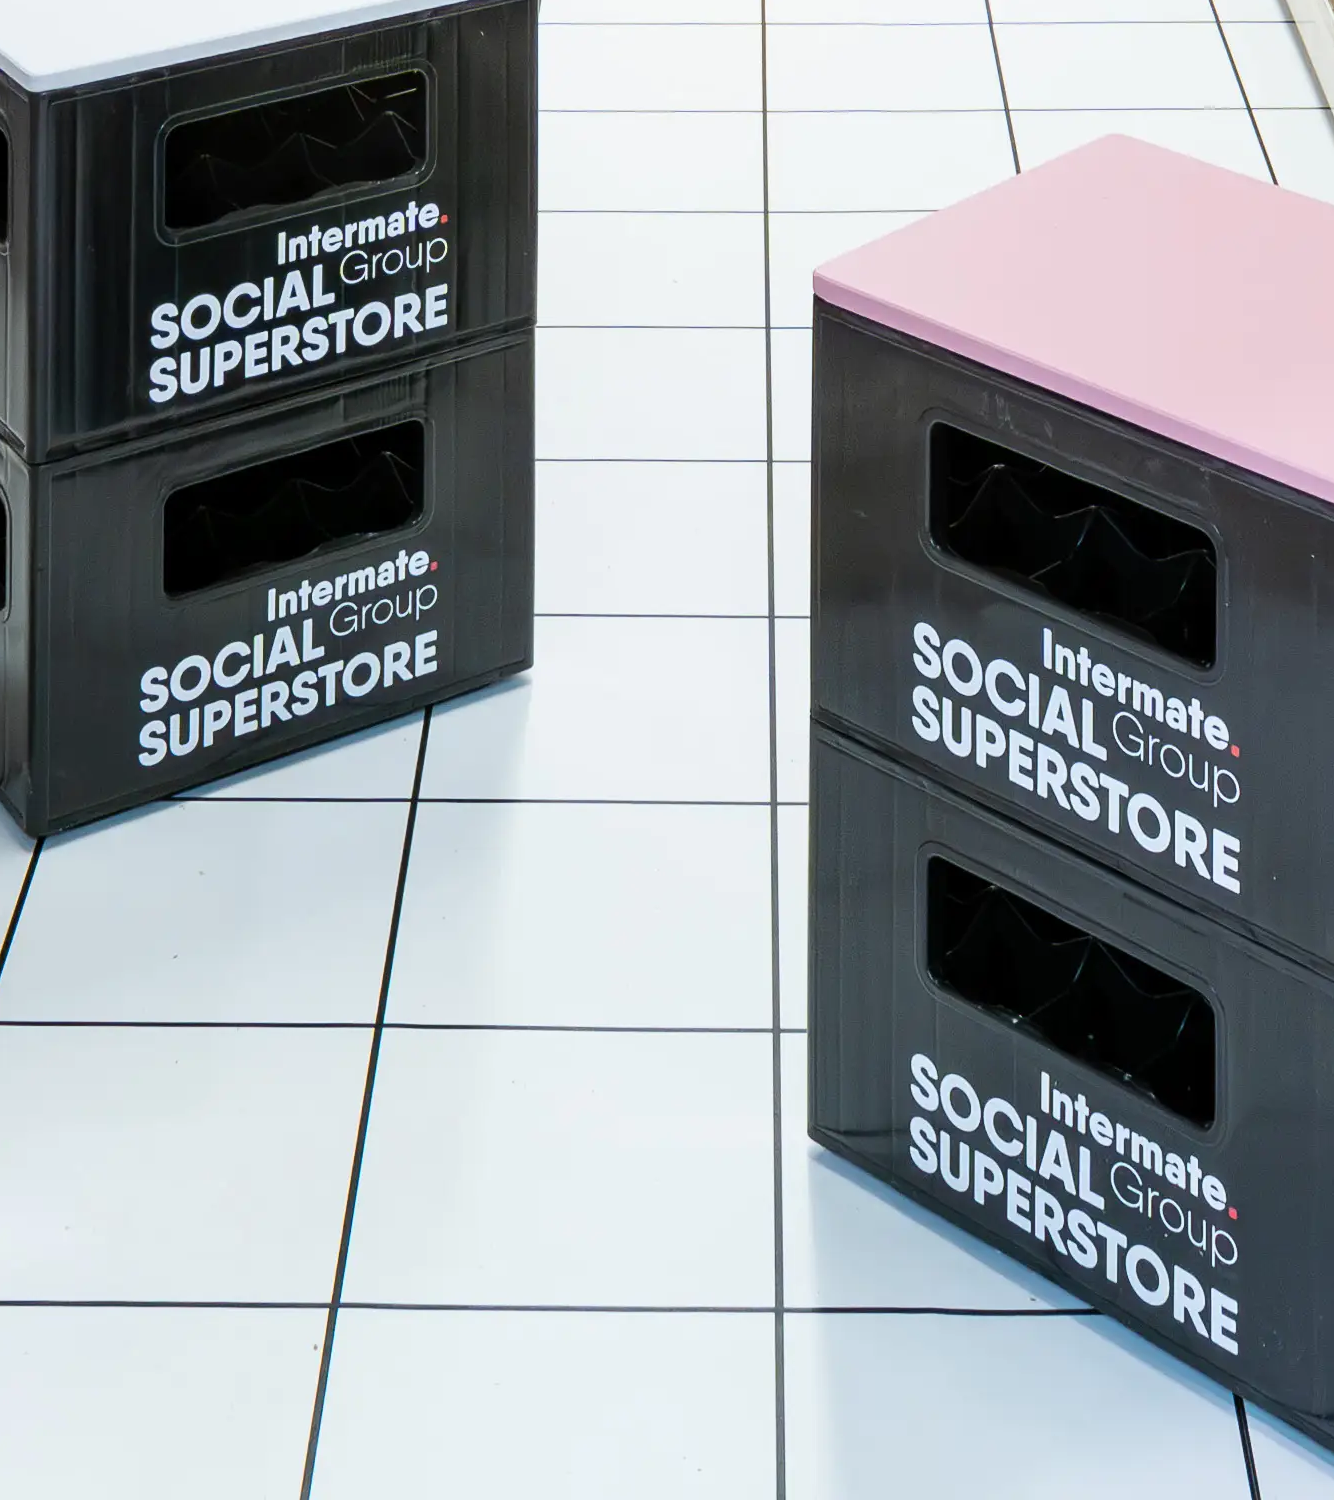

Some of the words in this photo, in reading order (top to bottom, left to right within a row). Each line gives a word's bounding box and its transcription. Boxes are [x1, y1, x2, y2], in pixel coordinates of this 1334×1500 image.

[277, 200, 449, 266] Intermate.
[340, 238, 448, 284] Group
[149, 284, 447, 402] SUPERSTORE
[151, 264, 335, 349] SOCIAL
[267, 549, 438, 622] Intermate.
[330, 584, 437, 636] Group
[139, 630, 437, 766] SUPERSTORE
[140, 618, 325, 713] SOCIAL
[913, 622, 1107, 761] SOCIAL
[1043, 628, 1239, 757] Intermate.
[912, 685, 1240, 894] SUPERSTORE
[1113, 711, 1240, 808] Group
[911, 1054, 1104, 1210] SOCIAL
[1041, 1071, 1237, 1219] Intermate.
[910, 1117, 1238, 1355] SUPERSTORE
[1111, 1162, 1238, 1268] Group
